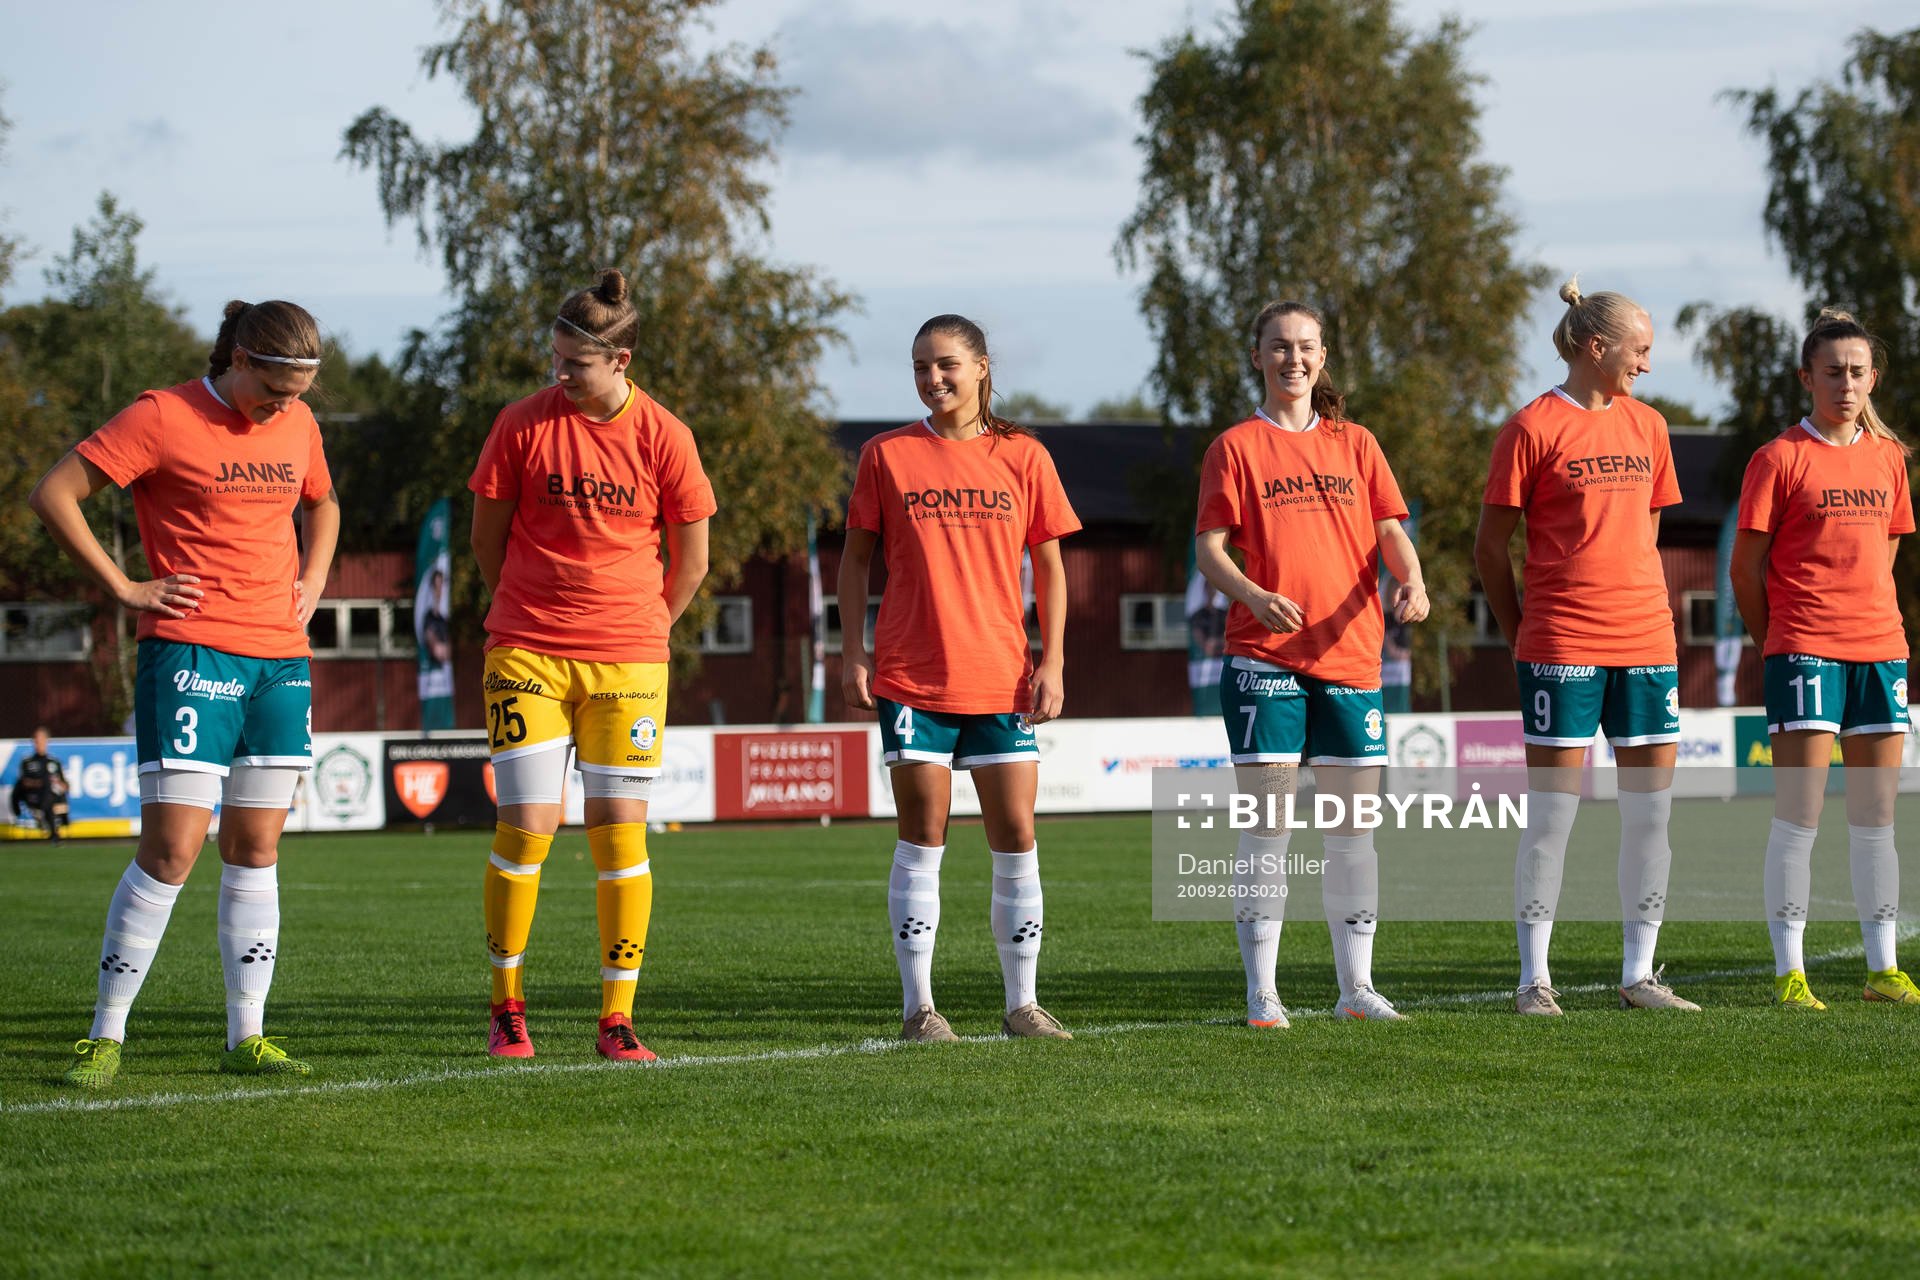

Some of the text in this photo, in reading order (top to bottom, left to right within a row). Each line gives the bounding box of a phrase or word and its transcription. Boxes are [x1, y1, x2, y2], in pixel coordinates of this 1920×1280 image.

[215, 462, 297, 483] JANNE
[1566, 455, 1651, 479] STEFAN
[200, 486, 212, 494] VI
[266, 486, 292, 494] EFTER
[547, 472, 636, 507] BJÖRN
[1261, 473, 1355, 499] JAN-ERIK
[1566, 482, 1576, 490] VI
[592, 504, 622, 516] EFTER
[903, 488, 1012, 511] PONTUS
[1318, 495, 1340, 503] EFER
[1816, 489, 1887, 508] JENNY
[963, 511, 993, 519] EFTER
[1860, 510, 1883, 518] EFTER
[173, 669, 246, 701] Vimpeln
[1789, 674, 1823, 716] 11
[490, 696, 528, 748] 25
[1534, 689, 1551, 732] 9
[173, 706, 199, 755] 3
[893, 704, 916, 745] 4
[1239, 705, 1258, 749] 7
[625, 754, 652, 762] CRAFT
